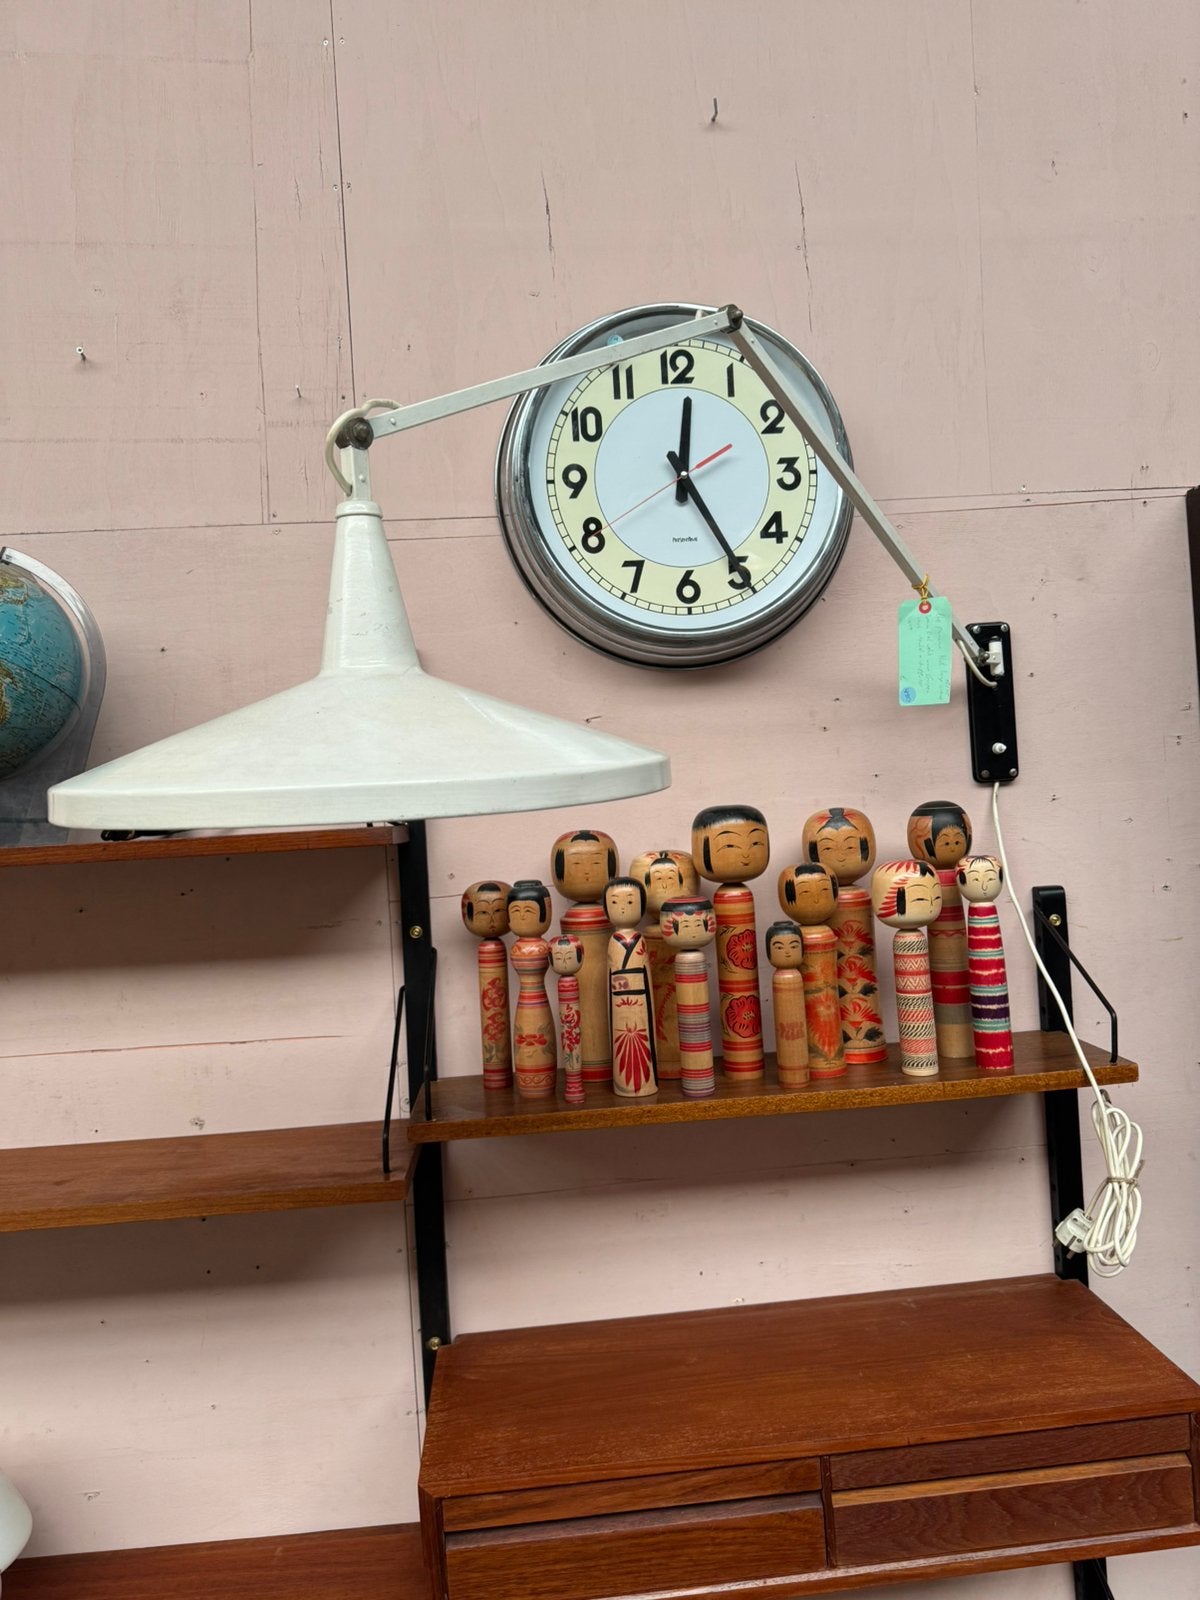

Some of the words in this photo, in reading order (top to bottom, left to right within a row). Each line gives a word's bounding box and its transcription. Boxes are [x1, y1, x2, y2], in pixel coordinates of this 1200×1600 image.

[612, 364, 634, 400] 11
[660, 349, 694, 384] 12
[727, 363, 734, 398] 1
[571, 406, 603, 442] 10
[760, 399, 785, 434] 2
[562, 464, 587, 499] 9
[776, 457, 801, 491] 3
[581, 517, 605, 553] 8
[760, 511, 788, 544] 4
[622, 560, 645, 593] 7
[676, 570, 700, 604] 6
[727, 556, 751, 590] 5
